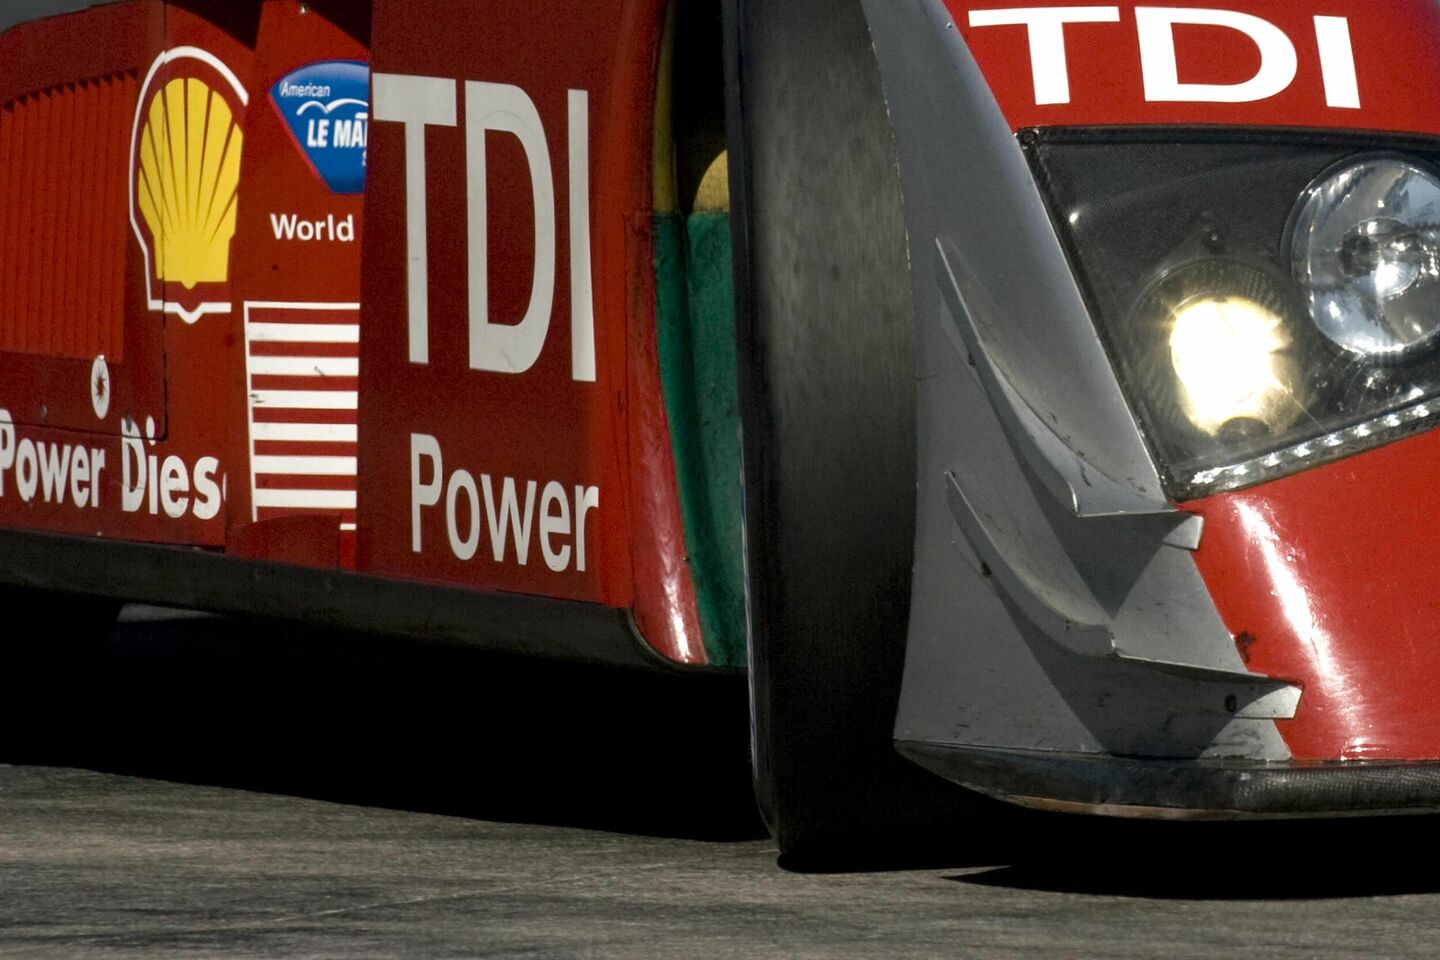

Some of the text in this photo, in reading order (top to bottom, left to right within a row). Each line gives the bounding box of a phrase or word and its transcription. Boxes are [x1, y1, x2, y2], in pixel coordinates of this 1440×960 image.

[280, 81, 331, 98] American
[968, 6, 1361, 110] TDI
[307, 118, 329, 148] LE
[270, 213, 354, 241] World
[372, 73, 596, 383] TDI
[121, 415, 227, 520] Dies
[410, 433, 599, 572] Power
